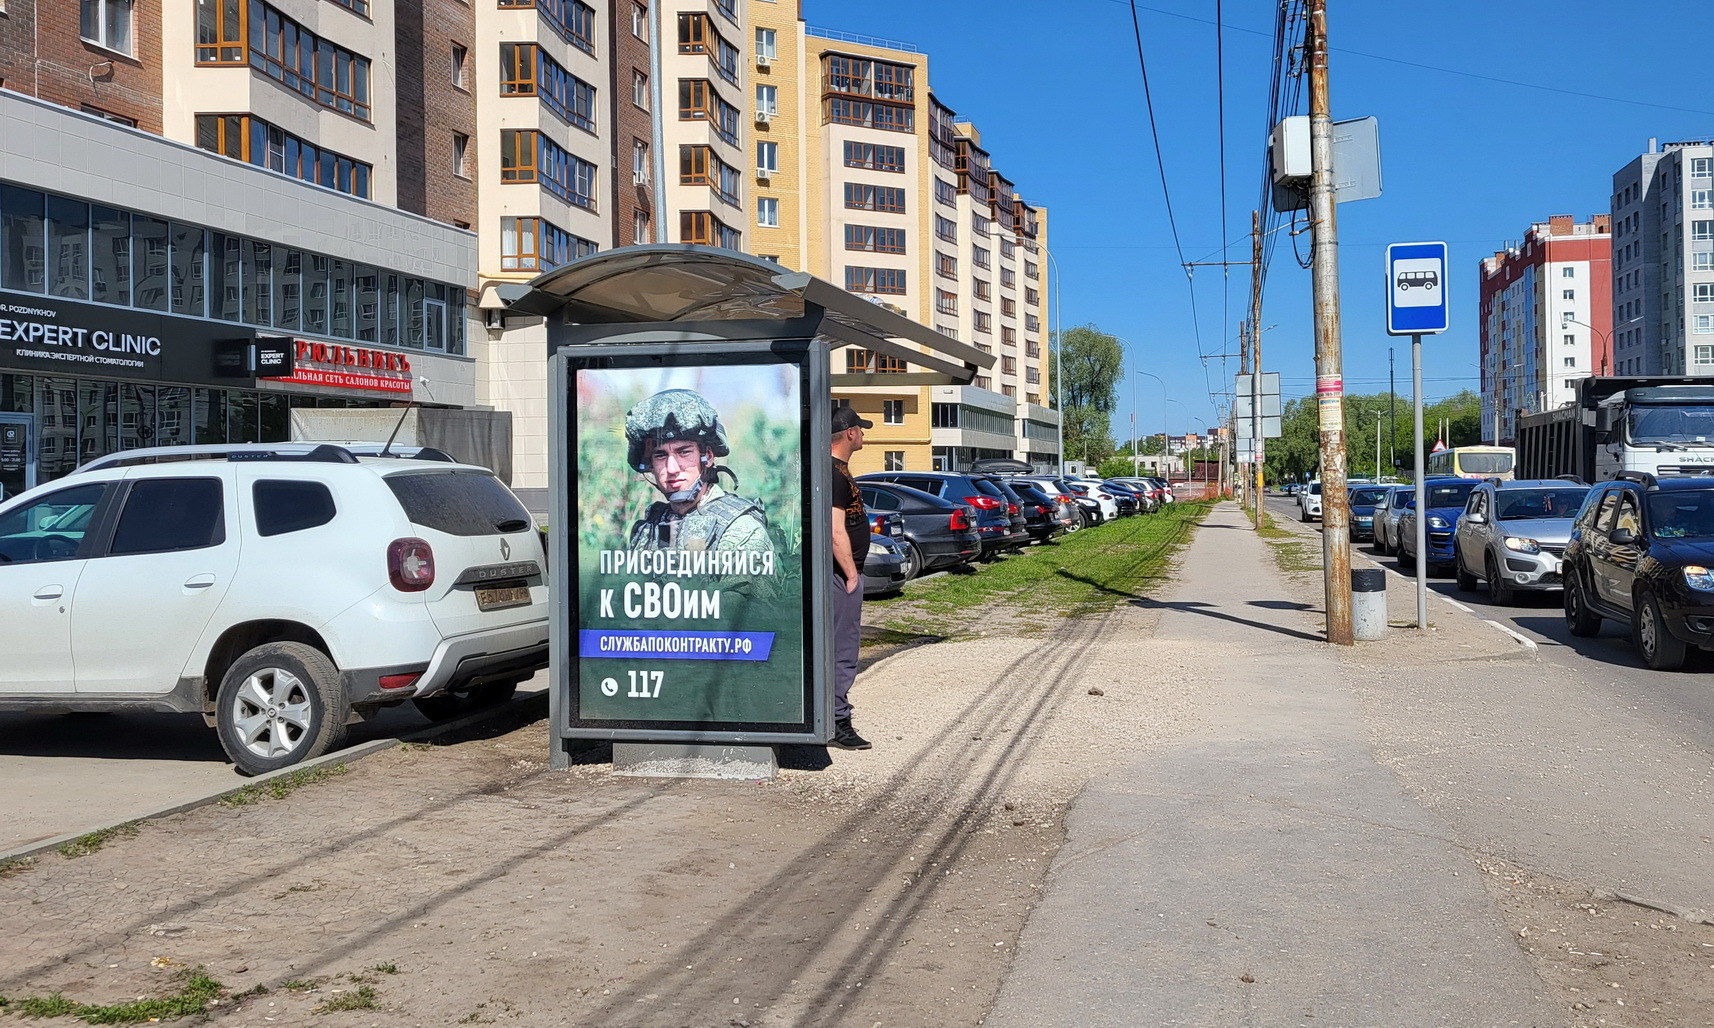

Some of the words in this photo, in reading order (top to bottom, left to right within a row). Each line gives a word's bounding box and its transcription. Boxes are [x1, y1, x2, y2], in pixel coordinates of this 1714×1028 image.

[0, 304, 8, 312] R.
[9, 305, 57, 318] POZDNYKHOV
[0, 318, 88, 348] EXPERT
[92, 330, 161, 356] CLINIC
[16, 348, 50, 359] КЛИНИКА
[50, 351, 94, 364] ЭКСПЕРТНОЙ
[95, 355, 144, 368] СТОМАТОЛОГИИ
[295, 340, 411, 372] РЮЛЬНИКЪ
[325, 374, 344, 384] СЕТЬ
[345, 376, 379, 387] САЛОНОВ
[380, 379, 410, 391] КРАСОТЫ
[479, 565, 532, 578] DUSTER
[599, 549, 775, 578] ПРИСОЕДИНЯЙСЯ
[599, 635, 753, 654] СЛУЖБАПОКОНТРАКТУ.РФ
[627, 670, 664, 699] 117
